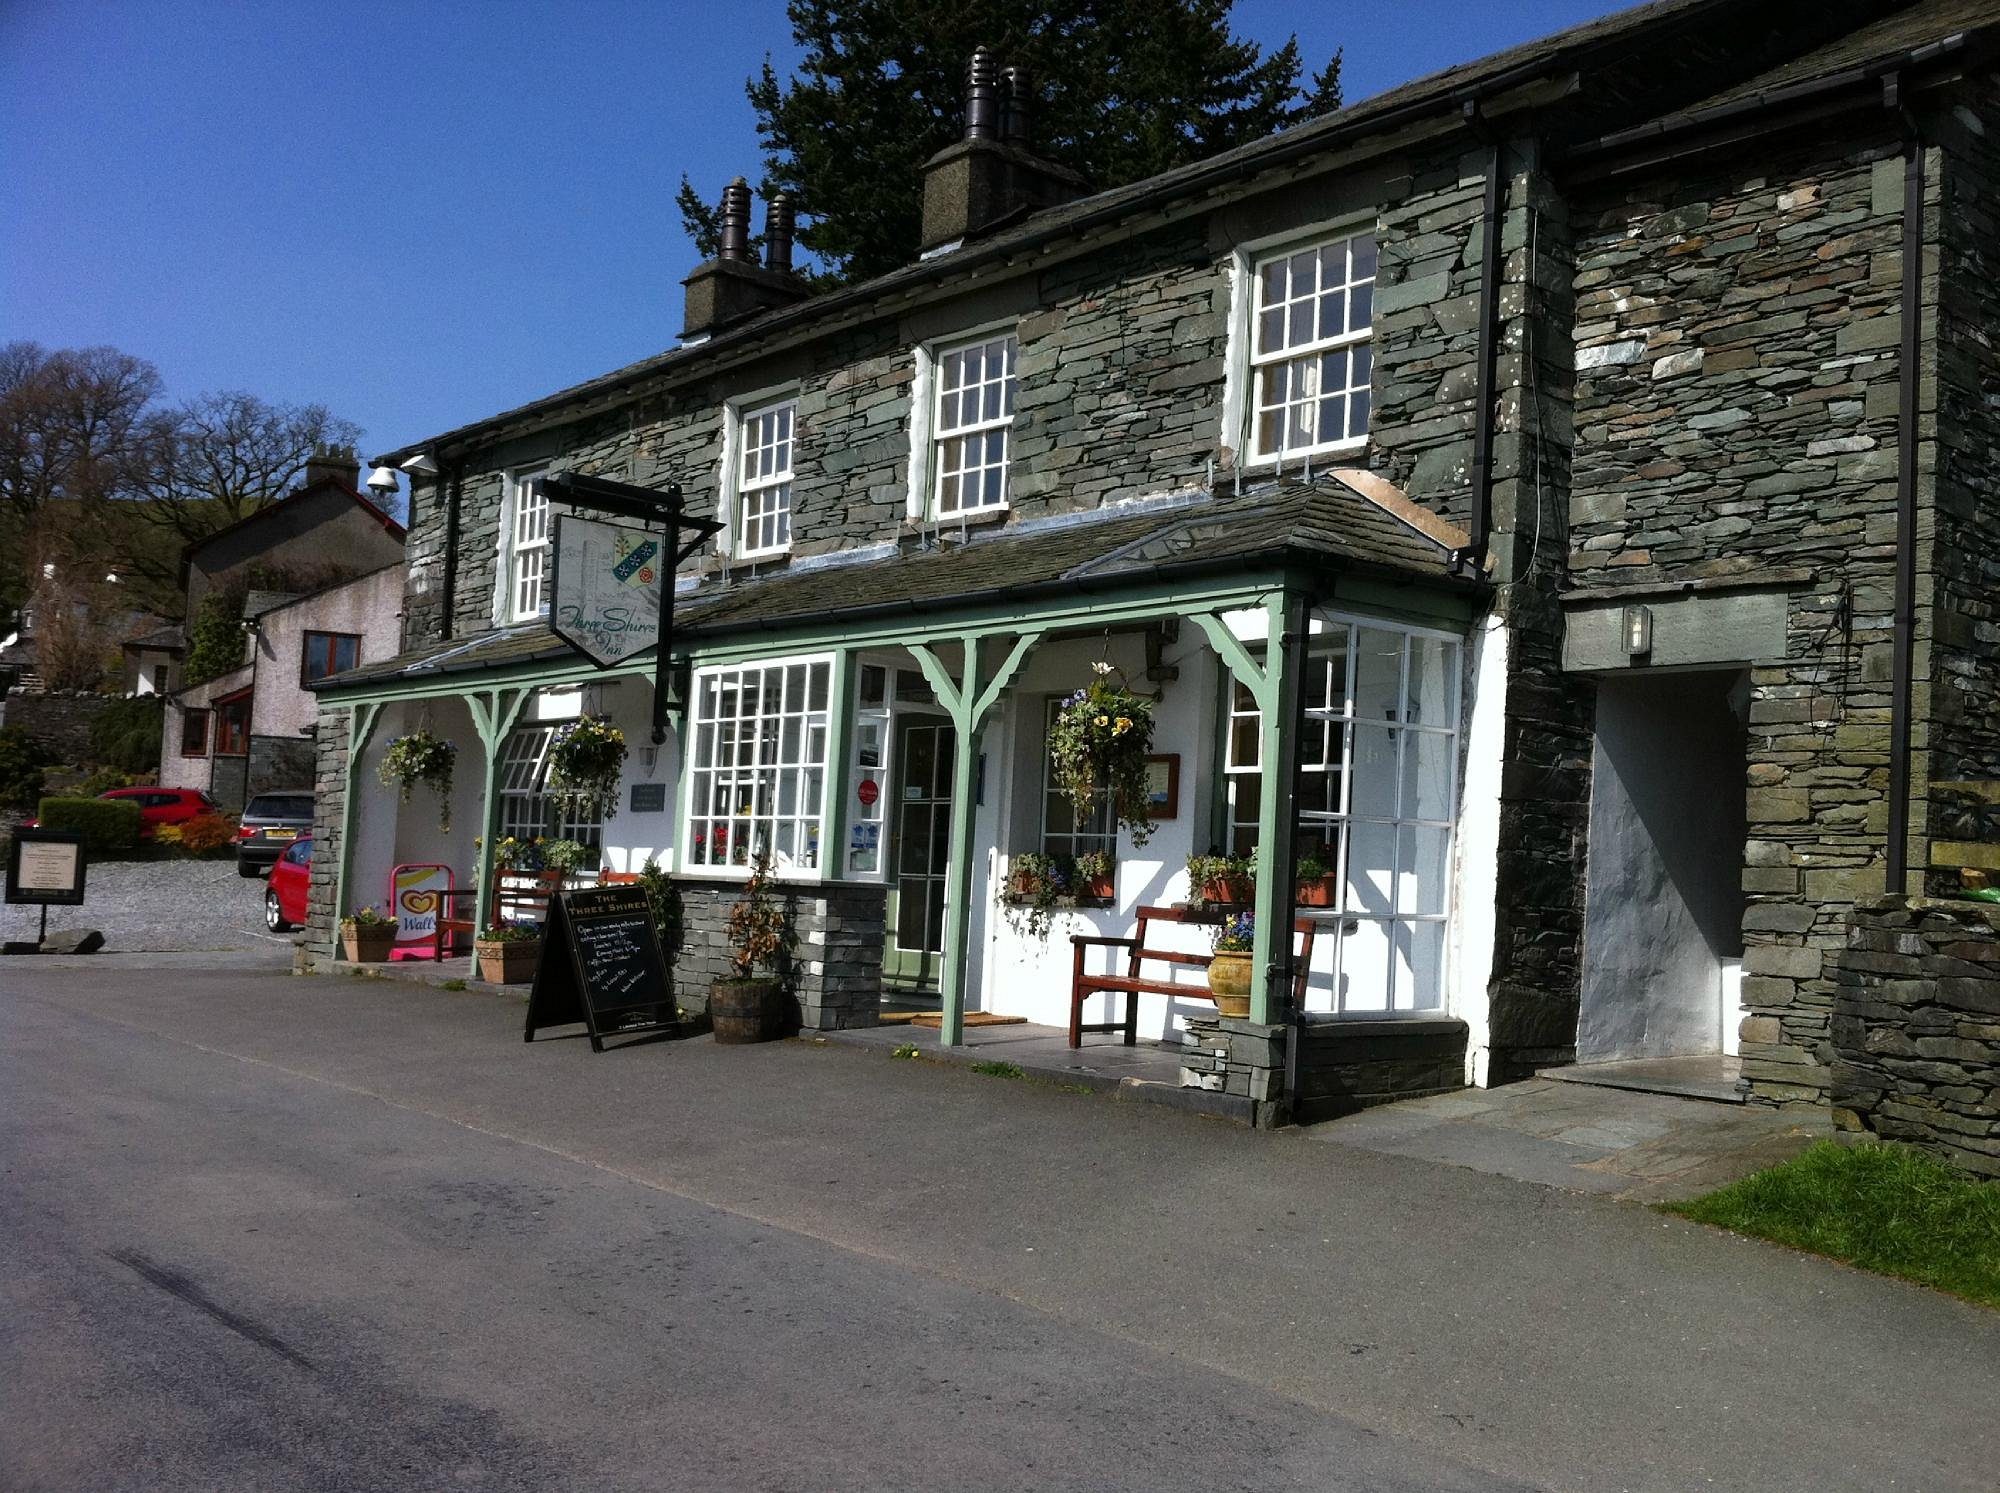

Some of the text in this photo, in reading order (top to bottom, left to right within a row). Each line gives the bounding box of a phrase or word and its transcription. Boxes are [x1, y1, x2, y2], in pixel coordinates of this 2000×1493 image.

[559, 606, 656, 632] Three Shires
[595, 631, 624, 655] Inn
[568, 901, 649, 916] THREE SHIRES
[595, 895, 617, 904] THE
